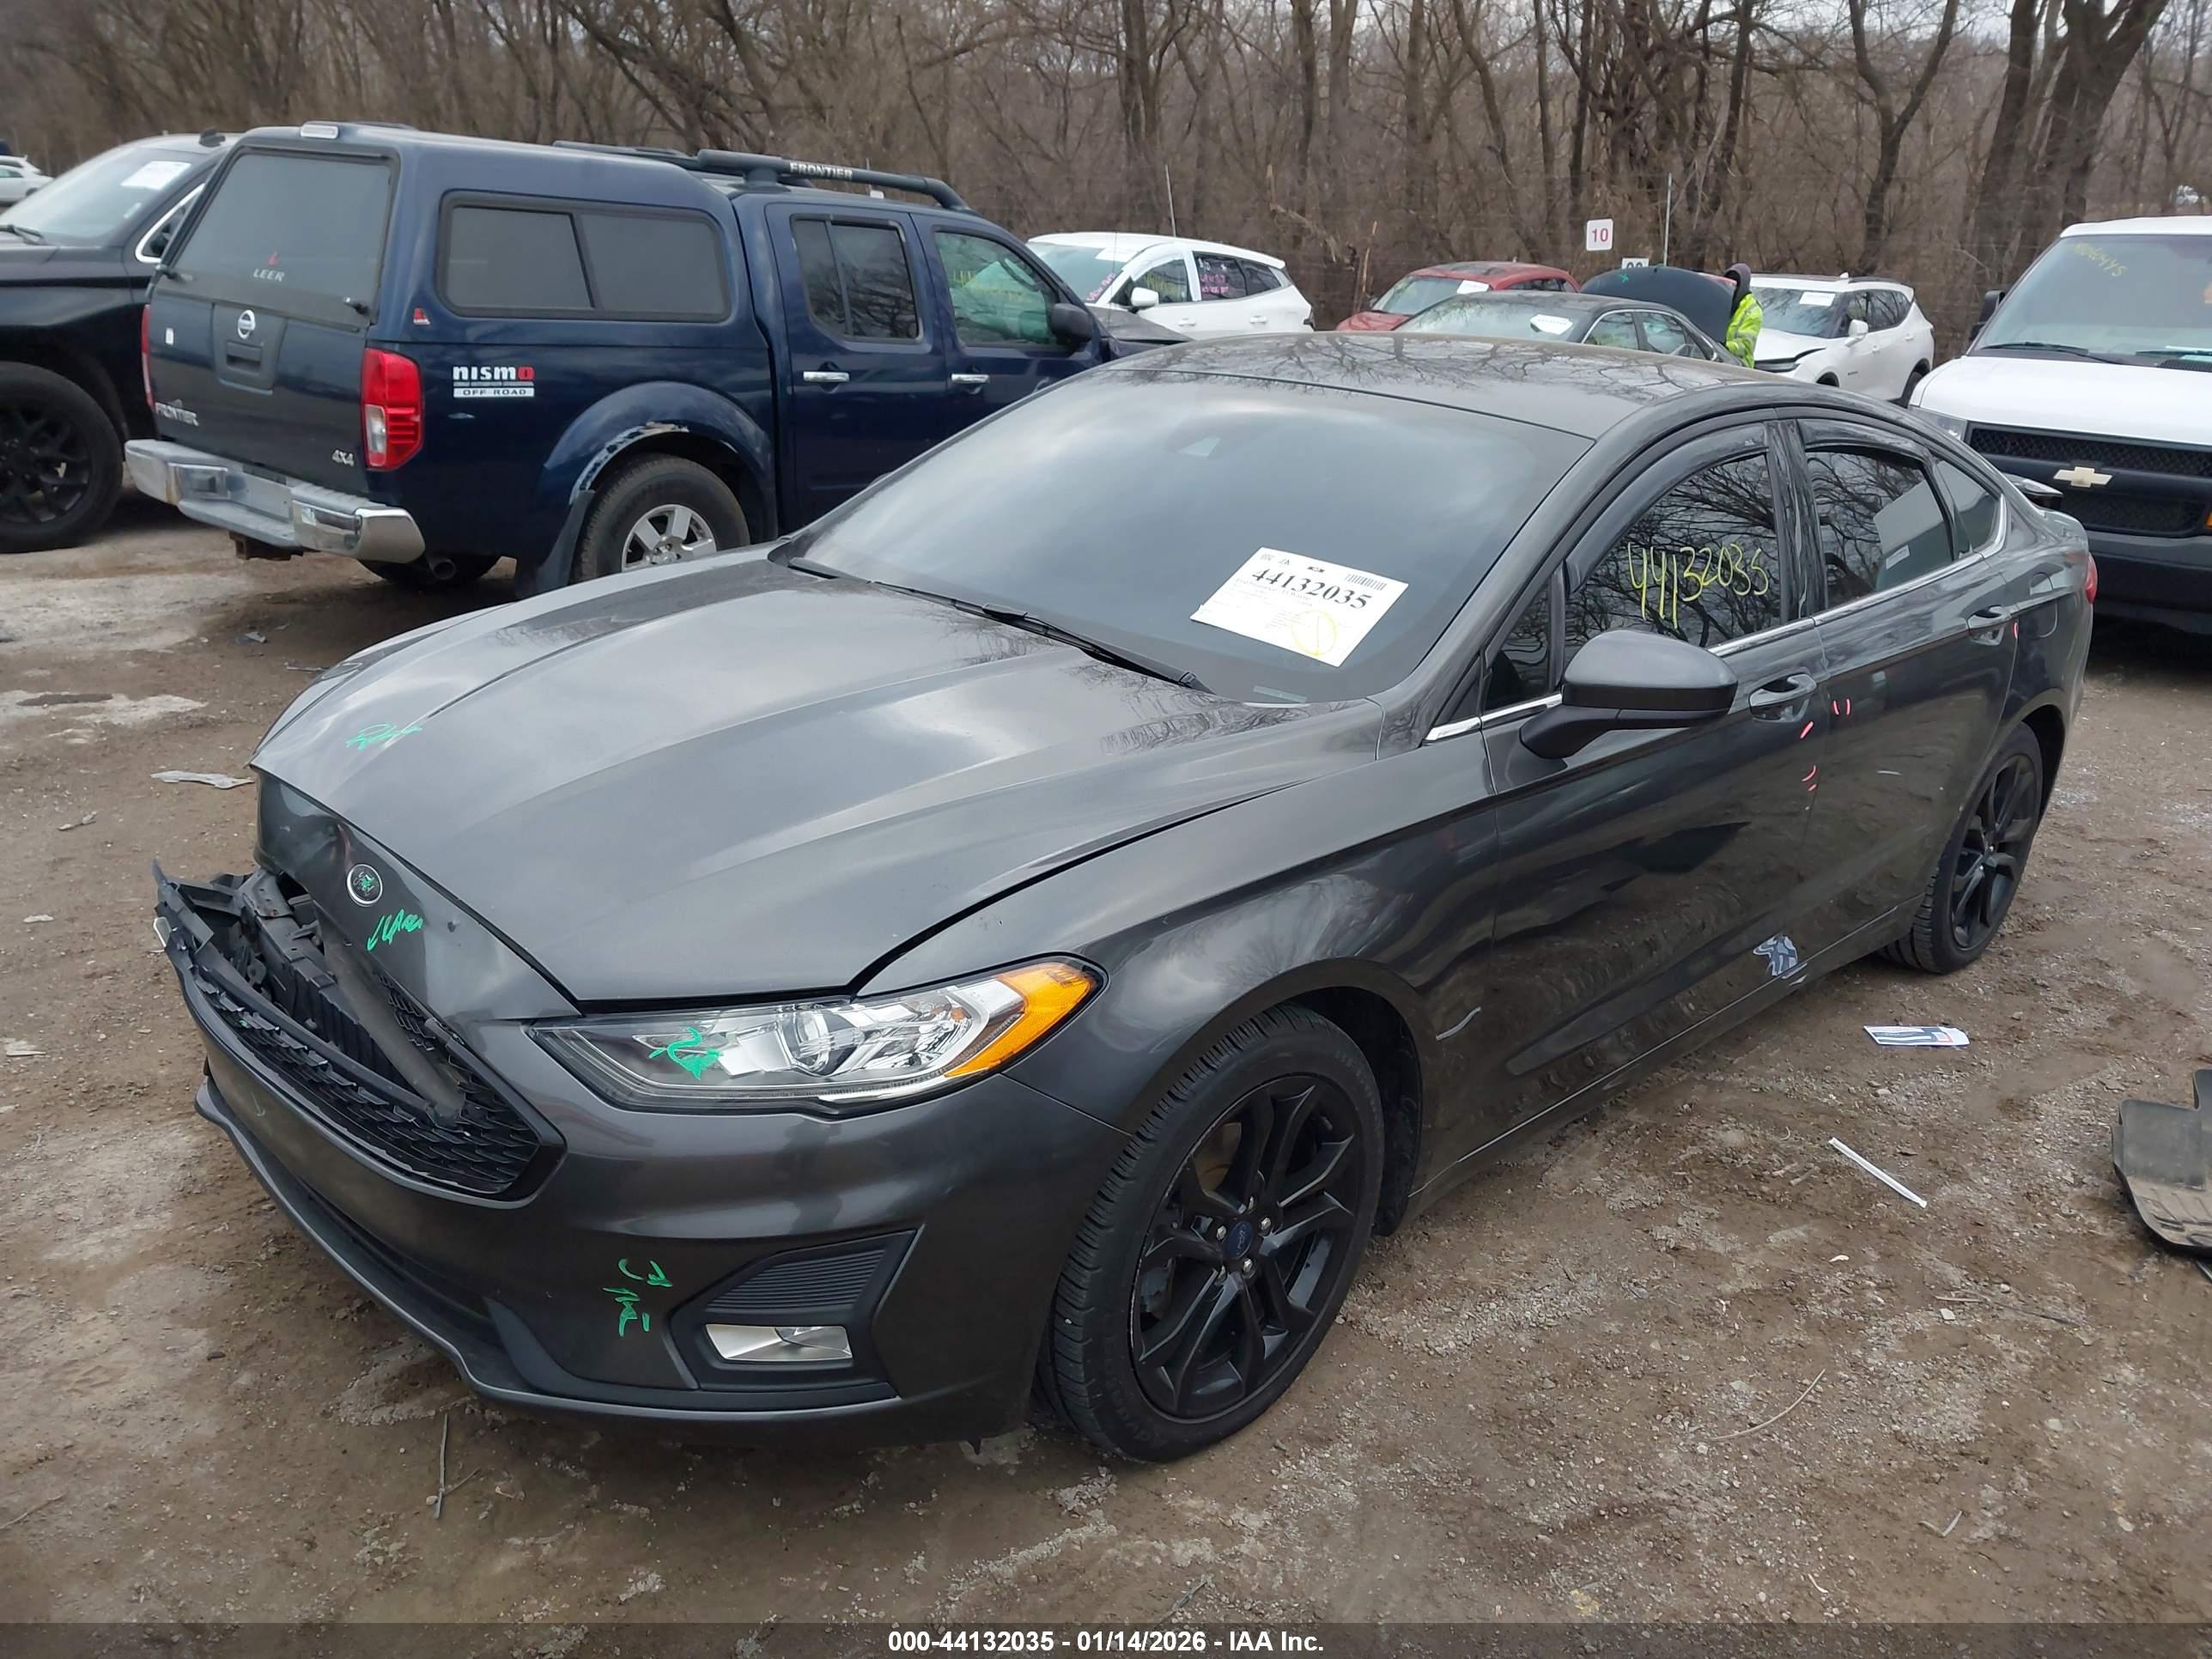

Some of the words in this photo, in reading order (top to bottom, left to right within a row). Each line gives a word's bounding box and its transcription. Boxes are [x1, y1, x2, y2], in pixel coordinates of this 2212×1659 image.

[789, 161, 853, 179] FRONTIER
[1591, 228, 1609, 243] 10
[253, 268, 285, 282] LEER
[1251, 568, 1372, 609] 44132035
[1628, 542, 1769, 629] 44132035
